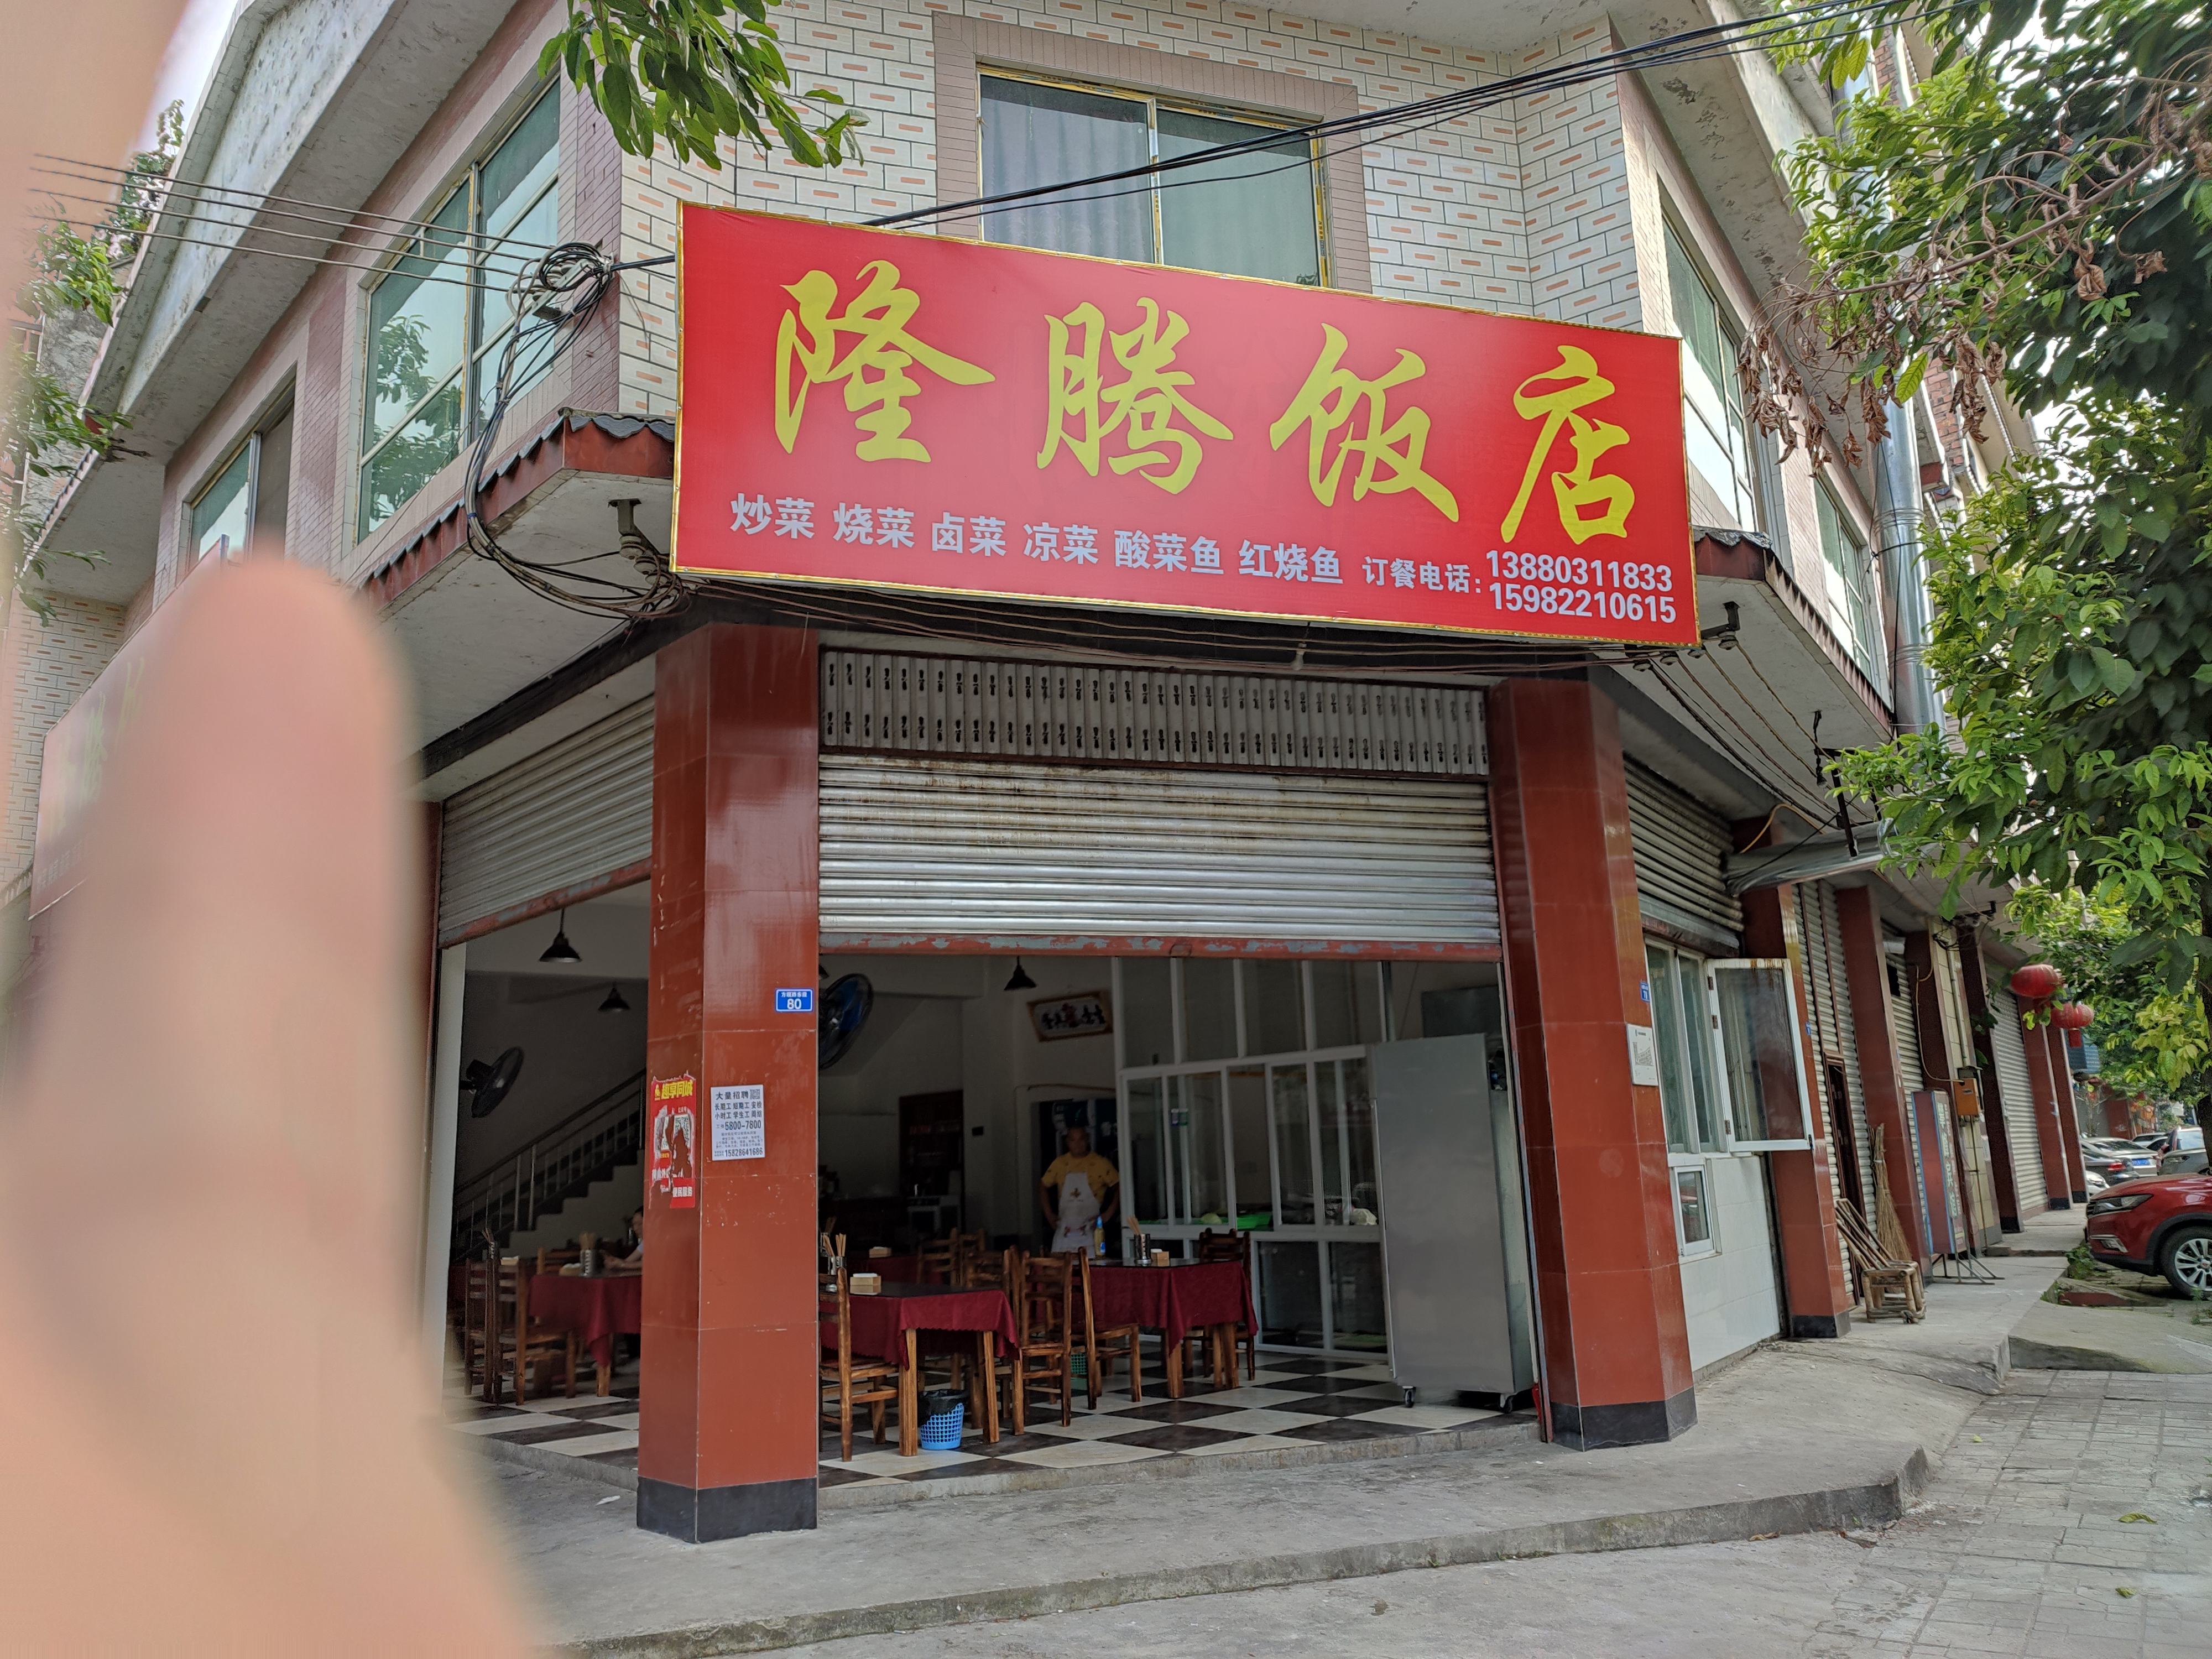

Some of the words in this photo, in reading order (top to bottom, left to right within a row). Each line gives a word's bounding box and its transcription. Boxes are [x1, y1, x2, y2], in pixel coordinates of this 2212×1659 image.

[775, 260, 1634, 544] 隆腾饭店
[732, 493, 814, 538] 炒菜
[834, 503, 914, 547] 烧菜
[932, 513, 1005, 556] 卤菜
[1024, 523, 1097, 564] 凉菜
[1115, 530, 1223, 573] 酸菜鱼
[1239, 540, 1342, 583] 红烧鱼
[1487, 550, 1672, 591] 13880311833
[1489, 582, 1676, 623] 15982210615
[787, 998, 802, 1010] 80
[716, 1091, 748, 1100] 大量招聘
[714, 1112, 731, 1120] 小时工
[725, 1120, 761, 1130] 5800-7800
